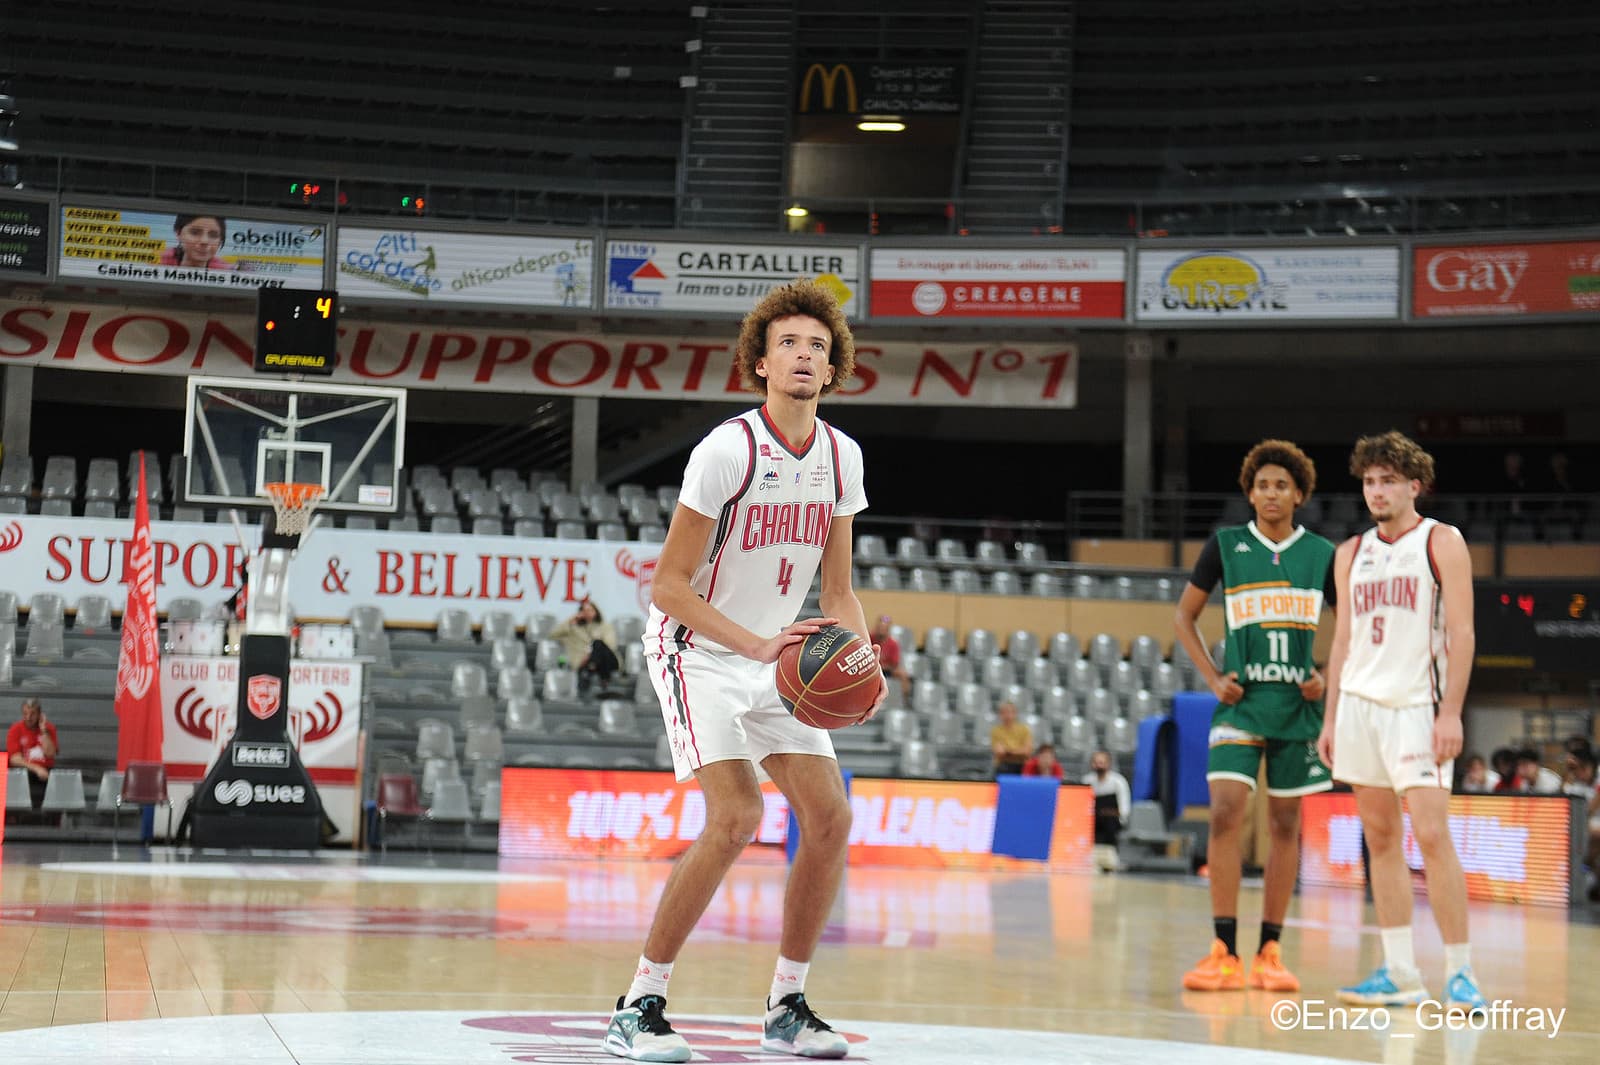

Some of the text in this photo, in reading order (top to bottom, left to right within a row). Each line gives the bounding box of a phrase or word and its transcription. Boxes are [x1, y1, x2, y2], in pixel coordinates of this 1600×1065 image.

[232, 228, 305, 249] abeille
[97, 263, 159, 278] Cabinet
[164, 269, 226, 284] Mathias
[678, 252, 844, 274] CARTALLIER
[1427, 251, 1529, 302] Gay
[676, 280, 771, 298] Immobili
[740, 501, 835, 552] CHALON
[322, 556, 350, 594] &
[375, 550, 591, 603] BELIEVE
[776, 556, 796, 596] 4
[1371, 616, 1385, 646] 5
[1266, 630, 1289, 663] 11
[171, 661, 209, 682] CLUB
[252, 784, 305, 803] suez
[567, 789, 675, 841] 100%
